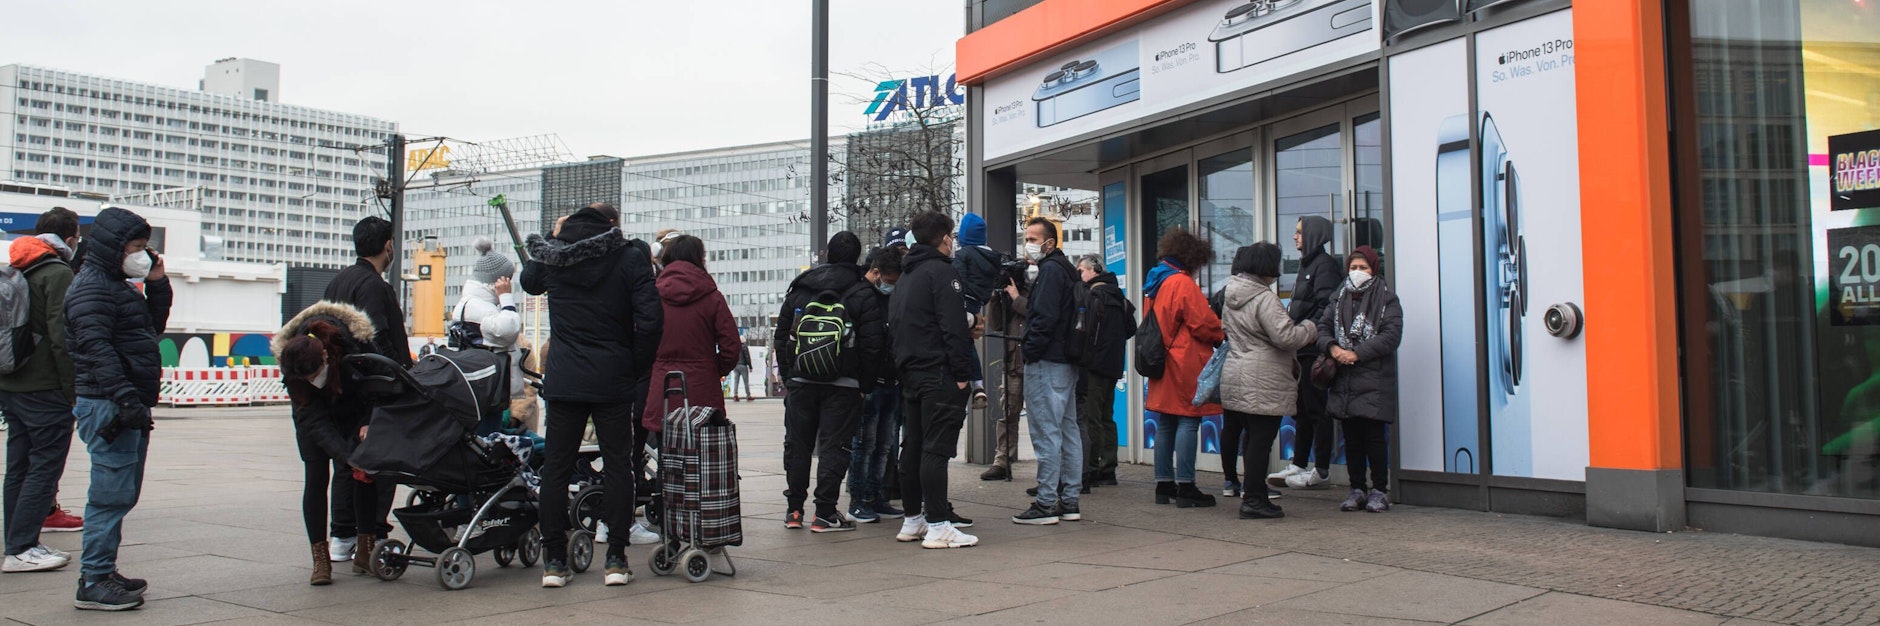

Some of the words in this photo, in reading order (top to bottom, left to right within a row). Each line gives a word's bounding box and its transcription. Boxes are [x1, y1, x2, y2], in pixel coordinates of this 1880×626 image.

[1159, 48, 1178, 60] iPhone
[1179, 43, 1185, 54] 13
[1186, 42, 1196, 53] Pro
[1505, 47, 1540, 64] iPhone
[1542, 41, 1553, 54] 13
[1555, 39, 1573, 52] Pro
[1492, 71, 1507, 83] So.
[1509, 65, 1534, 79] Was.
[1536, 60, 1559, 72] Von.
[407, 146, 450, 172] ADAC
[1837, 149, 1880, 172] BLAC
[1839, 244, 1880, 284] 20
[1841, 285, 1880, 304] ALL
[482, 518, 503, 527] Safety
